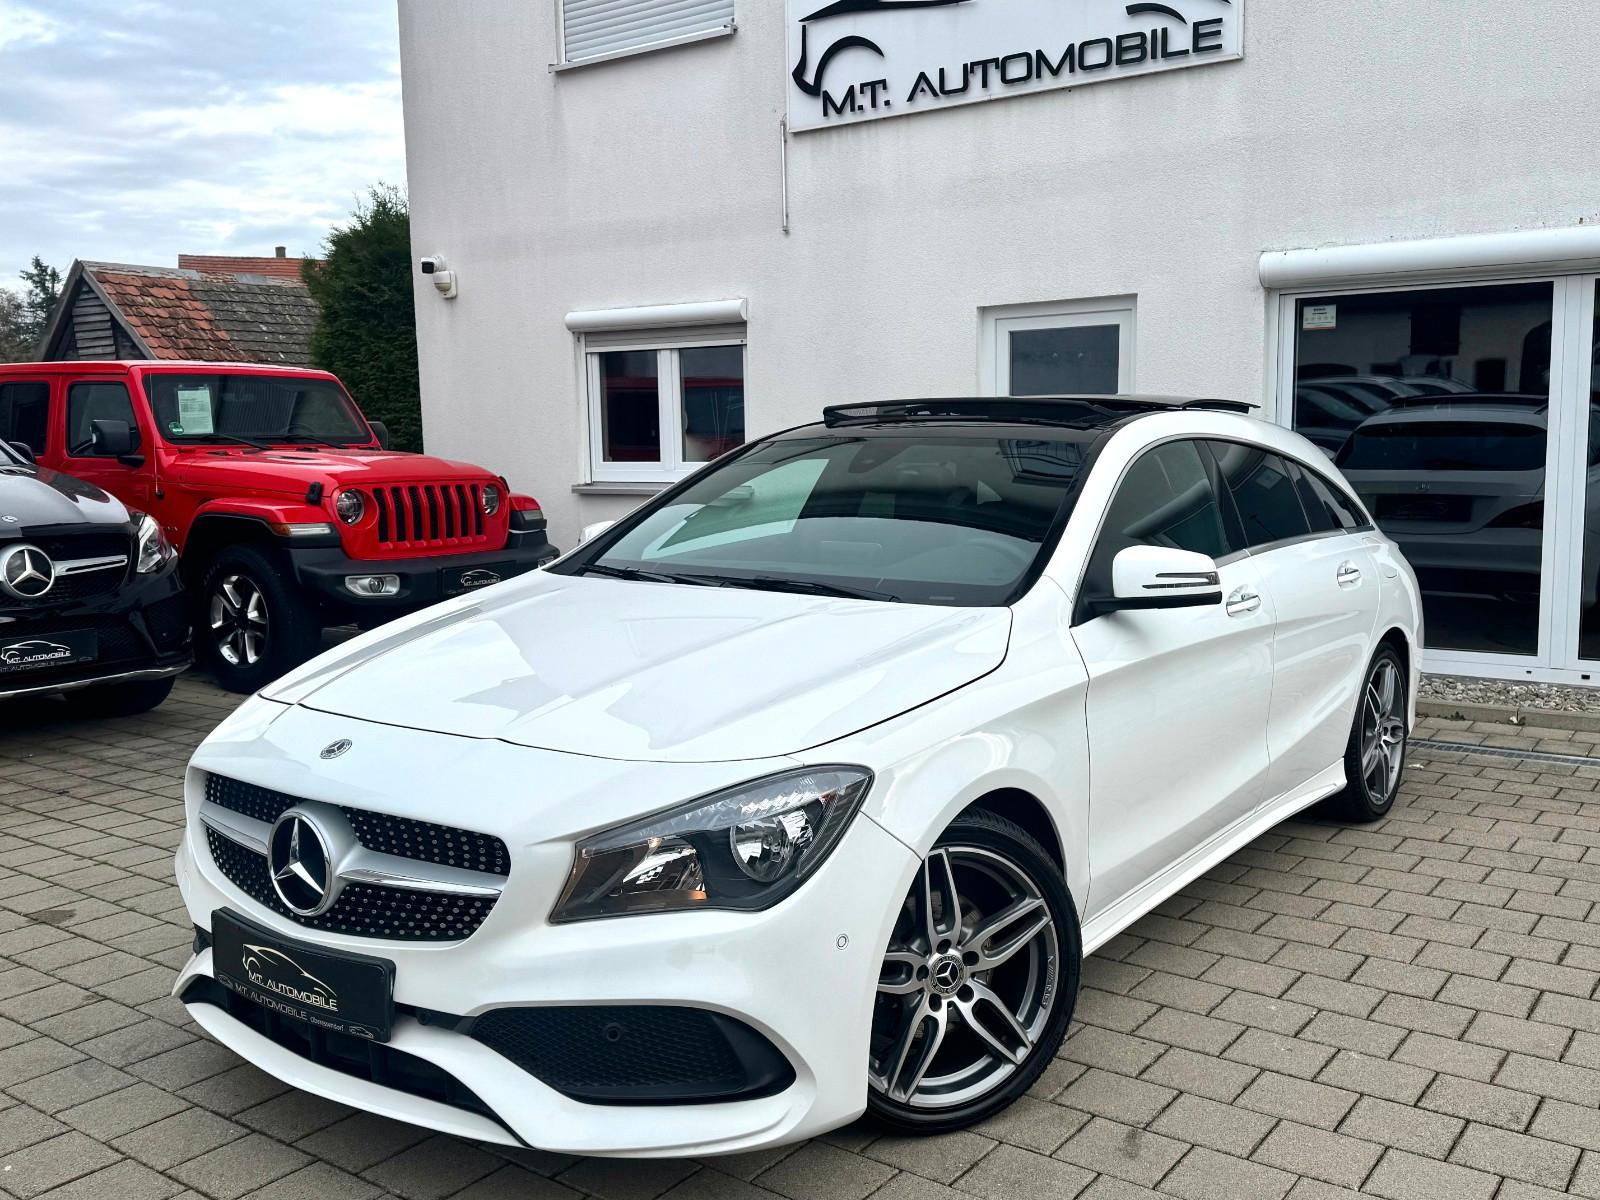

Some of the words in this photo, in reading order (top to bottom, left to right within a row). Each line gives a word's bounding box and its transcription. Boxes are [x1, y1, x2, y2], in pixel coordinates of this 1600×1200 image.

[822, 79, 891, 117] M.T.
[906, 17, 1224, 102] AUTOMOBILE
[23, 651, 71, 662] AUTOMOBILE
[251, 991, 308, 1020] AUTOMOBILE
[266, 979, 339, 1012] AUTOMOBILE
